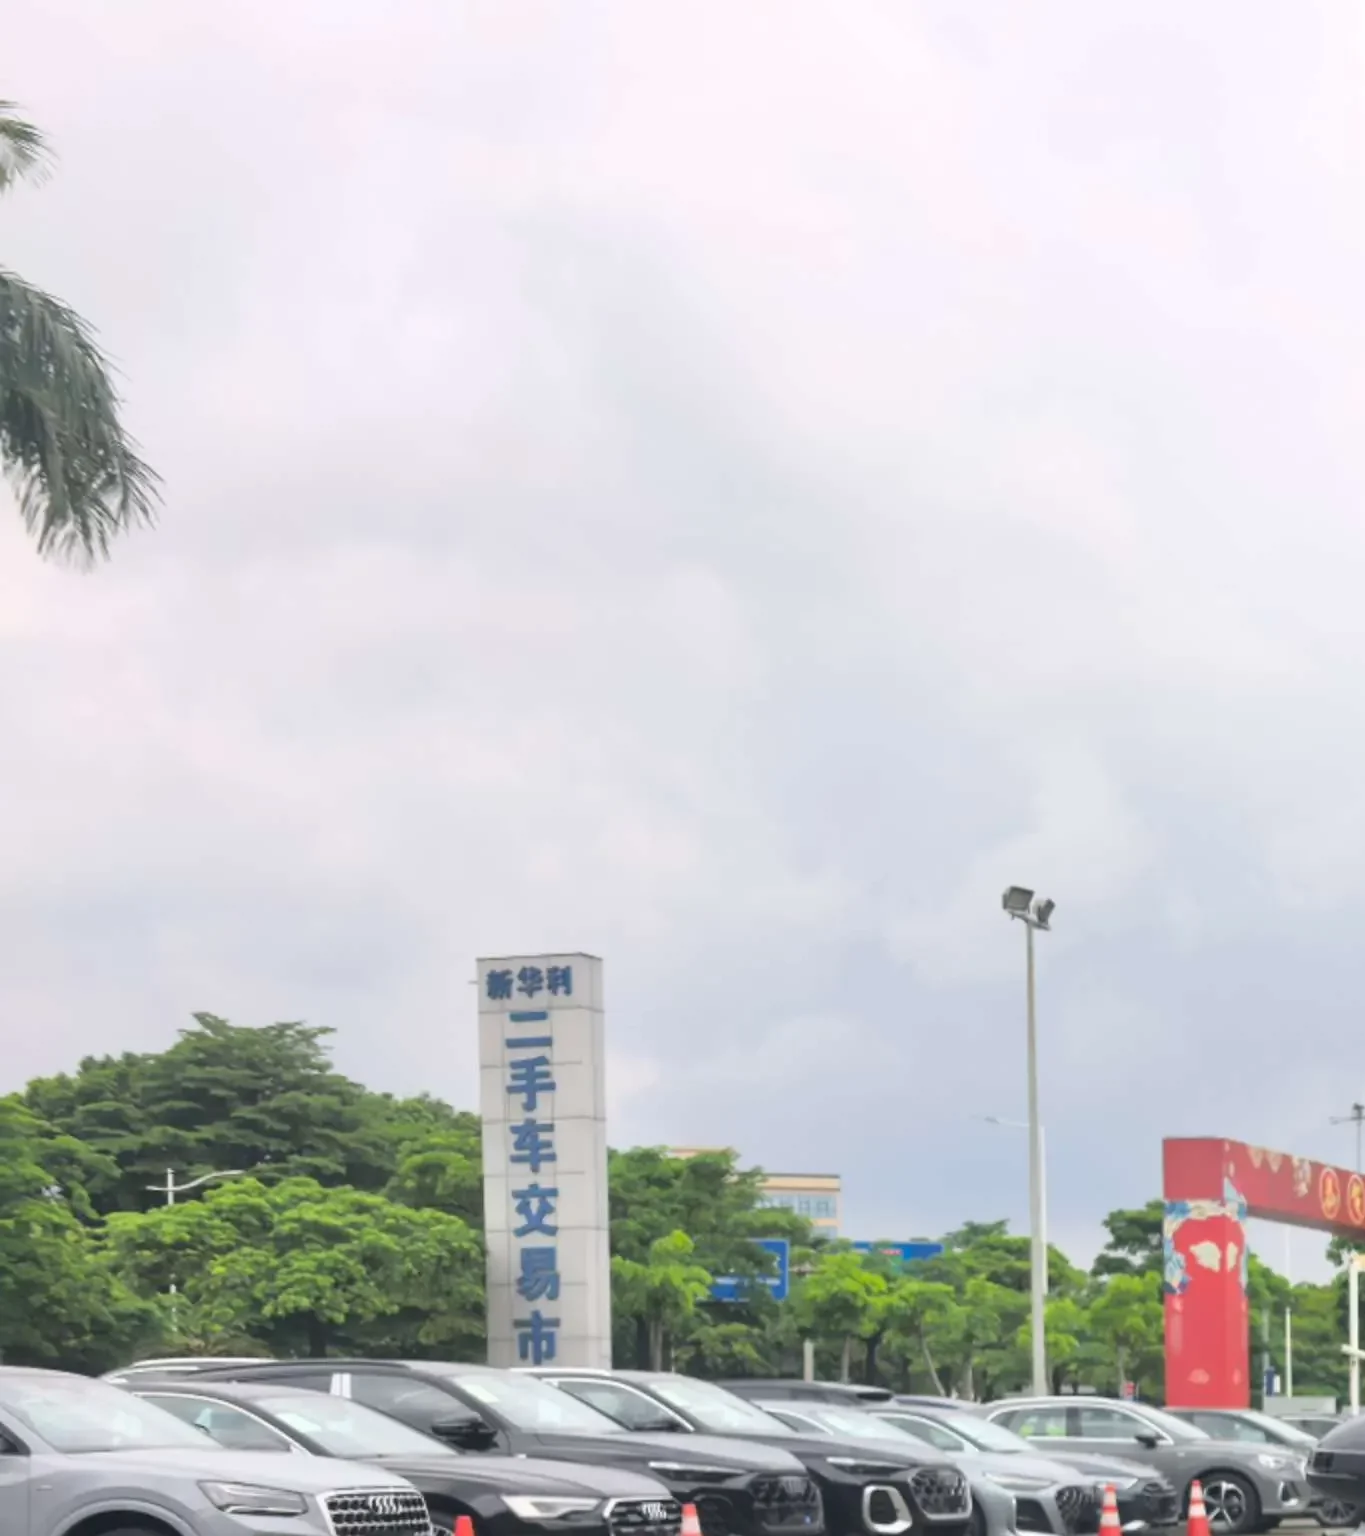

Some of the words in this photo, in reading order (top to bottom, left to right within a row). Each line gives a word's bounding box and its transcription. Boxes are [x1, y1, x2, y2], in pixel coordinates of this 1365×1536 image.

[505, 1011, 561, 1366] 二手车交易市
